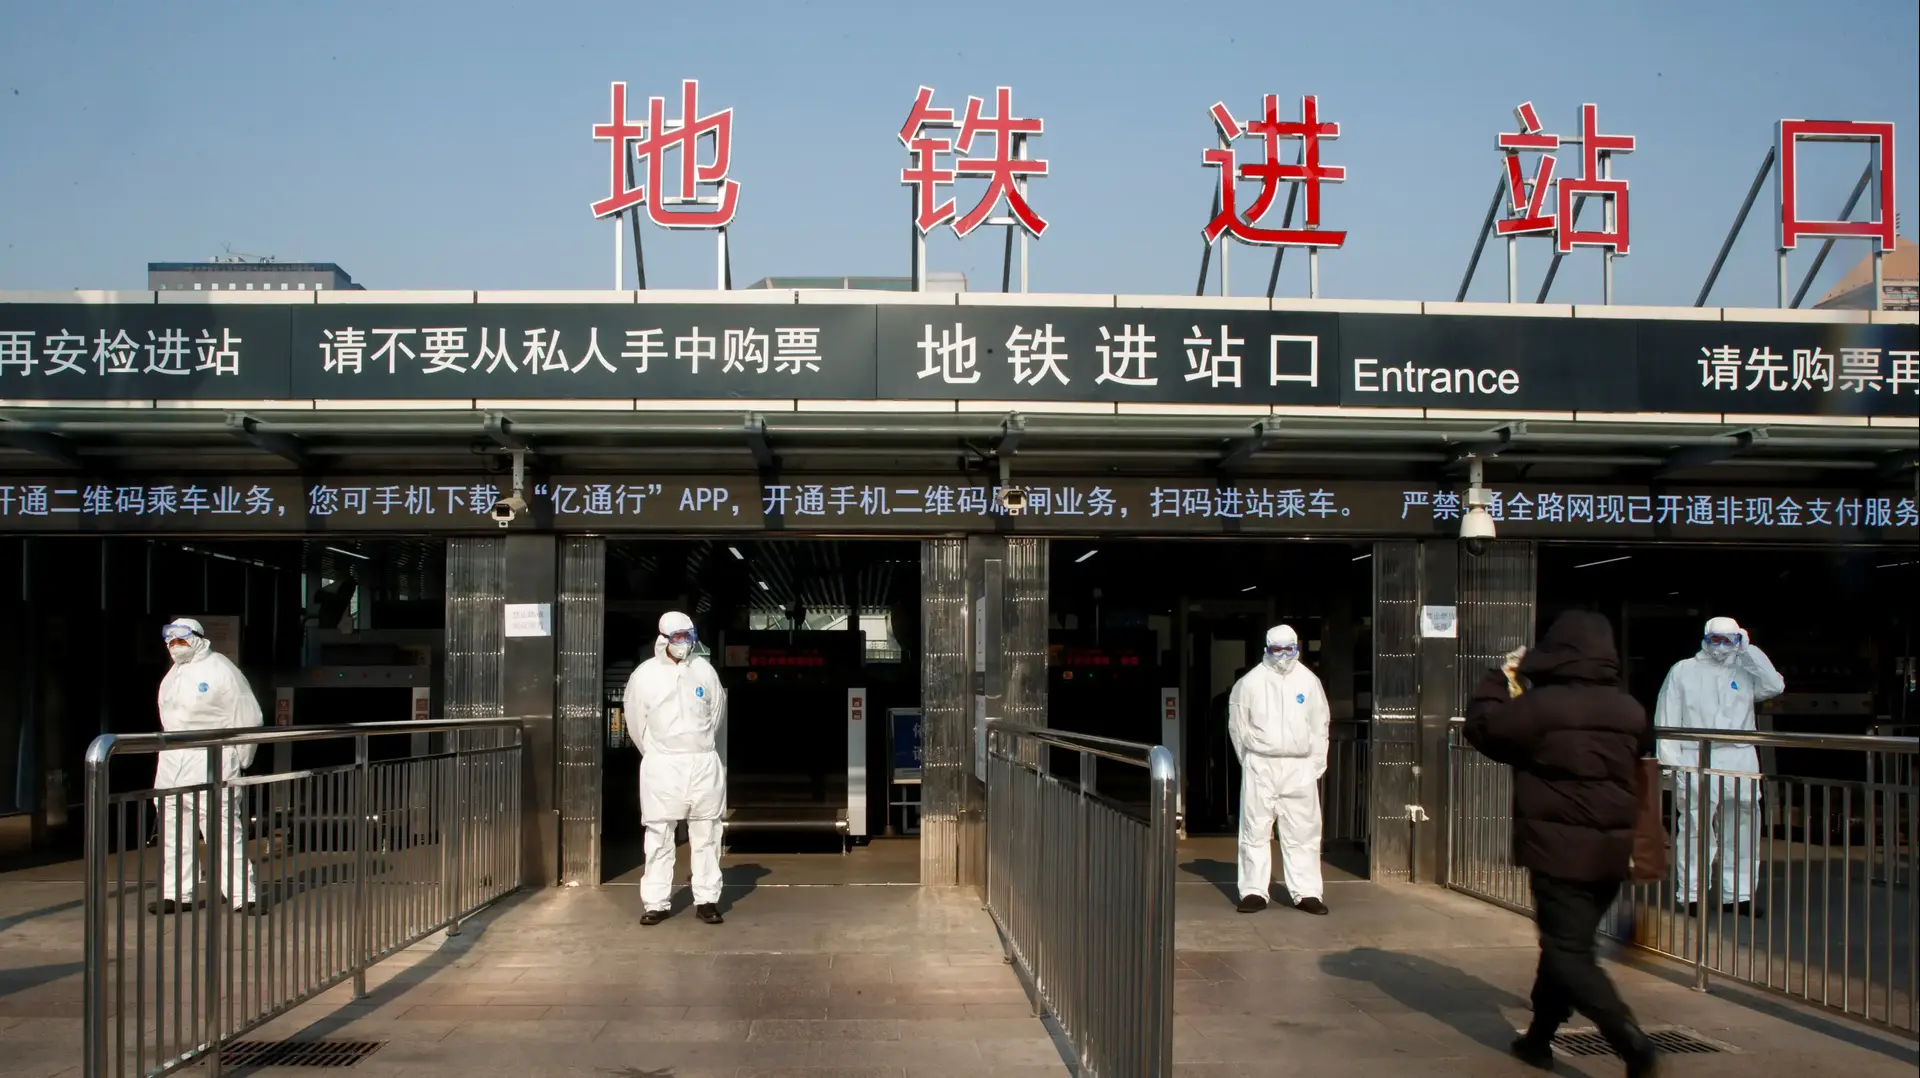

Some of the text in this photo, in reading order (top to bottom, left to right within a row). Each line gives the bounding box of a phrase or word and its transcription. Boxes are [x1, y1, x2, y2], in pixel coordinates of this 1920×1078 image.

[591, 79, 1897, 254] 地铁进站口
[0, 328, 243, 376] 再安检进站
[319, 326, 822, 375] 请不要从私人手中购票
[917, 323, 1520, 394] 地铁进站口 Entrance
[1698, 345, 1919, 395] 请先购票再
